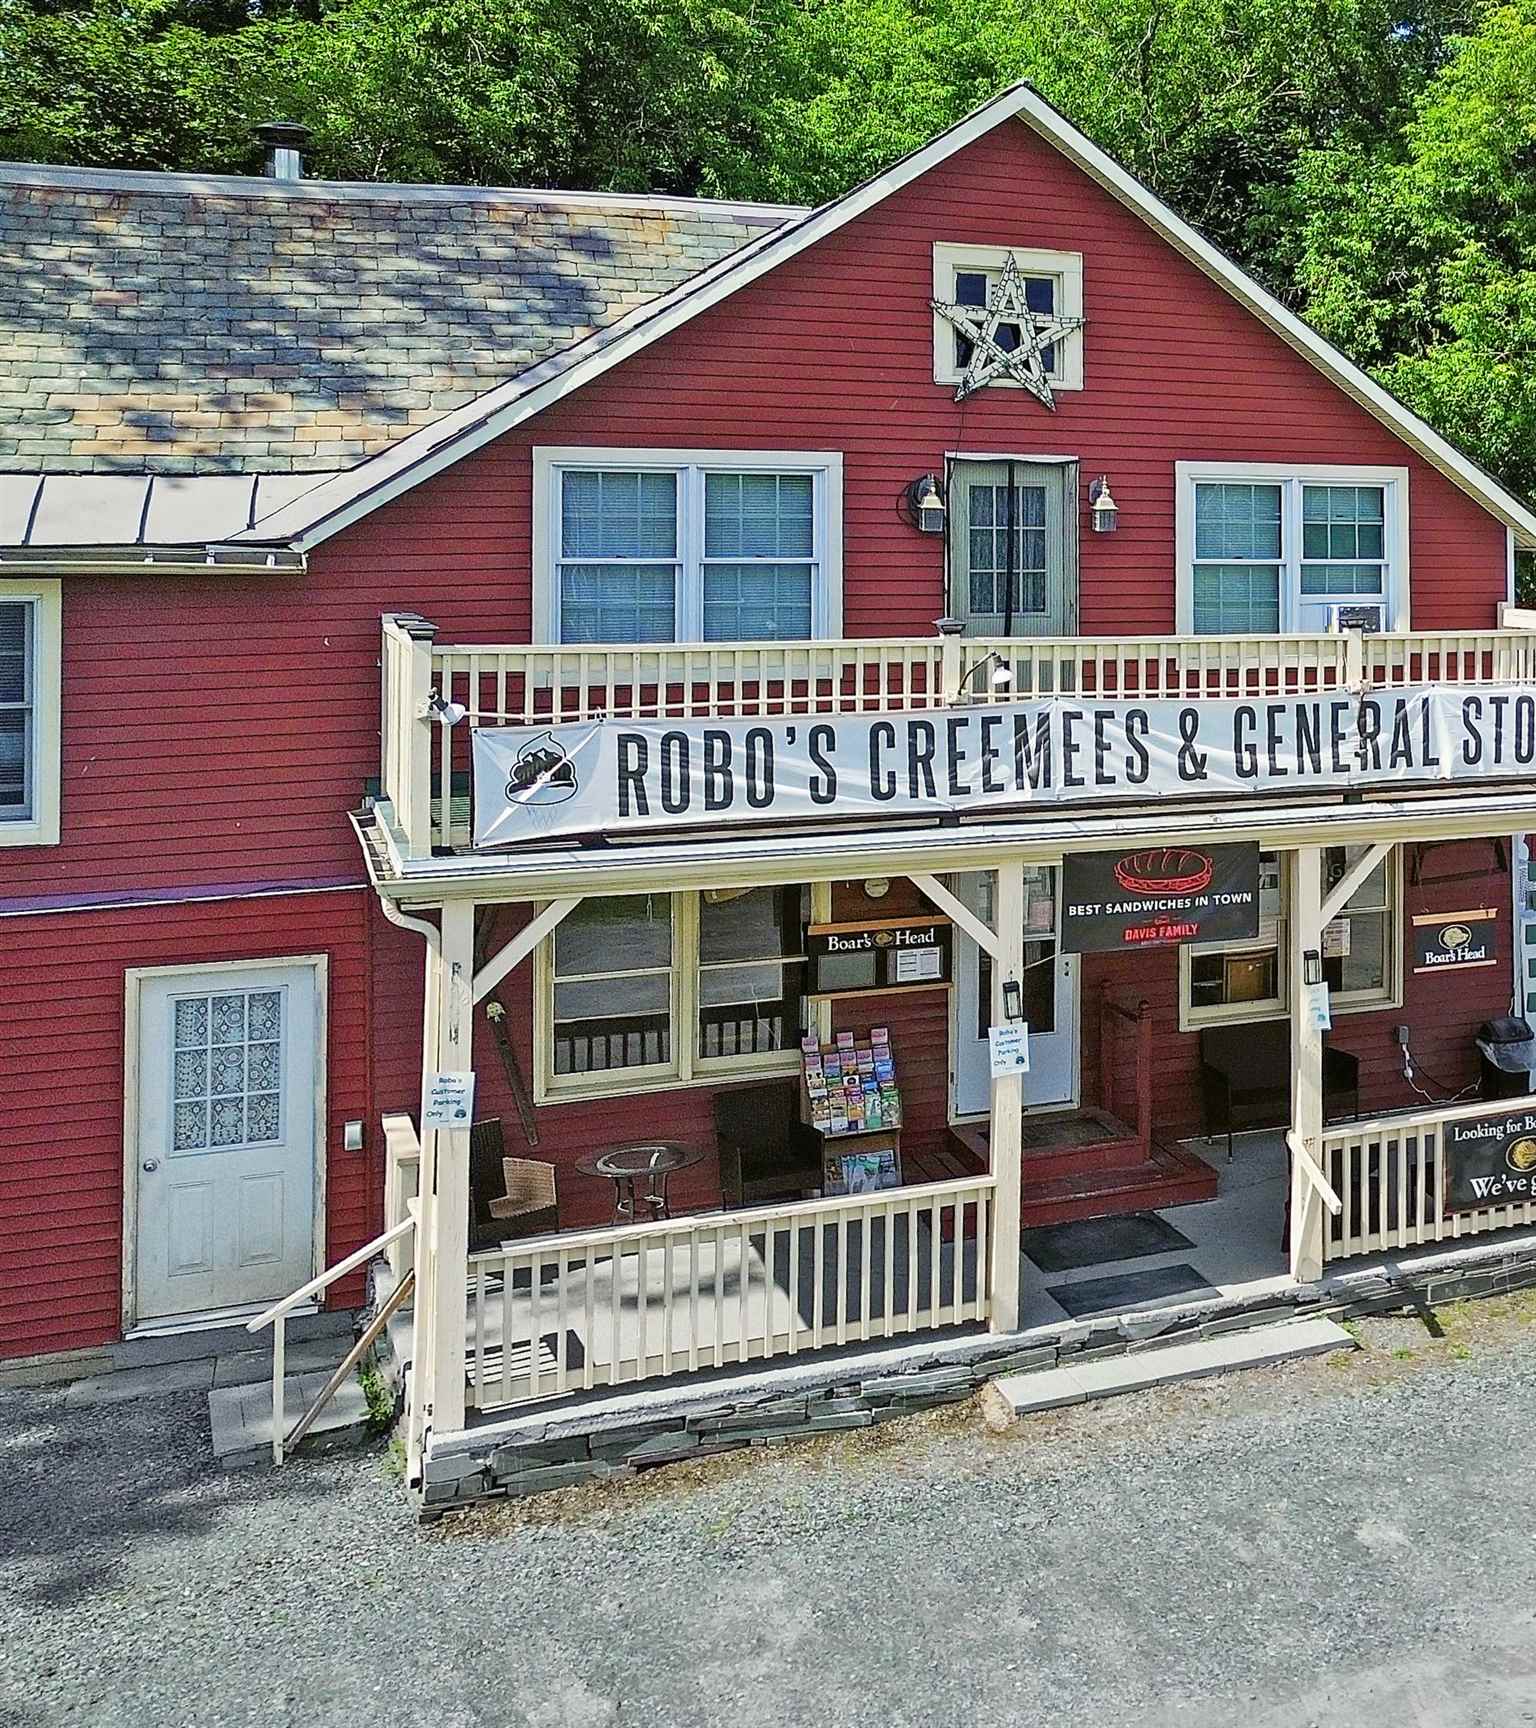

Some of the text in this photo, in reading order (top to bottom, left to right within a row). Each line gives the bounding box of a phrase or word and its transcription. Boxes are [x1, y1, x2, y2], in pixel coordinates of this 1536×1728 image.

[616, 723, 838, 818] ROBO'S
[869, 708, 1150, 801] CREEMEES
[1177, 706, 1209, 782] &
[1232, 696, 1441, 779] GENERAL
[1068, 904, 1101, 917] BEST
[1105, 898, 1191, 914] SANDWICHES
[1195, 896, 1208, 907] IN
[1212, 893, 1252, 905] TOWN
[827, 927, 935, 951] Boar's Head
[1125, 922, 1198, 941] DAVIS FAMILY
[1425, 945, 1486, 965] Boar's Head
[1454, 1123, 1504, 1141] Looking
[1506, 1118, 1523, 1134] for
[1469, 1174, 1527, 1199] We've
